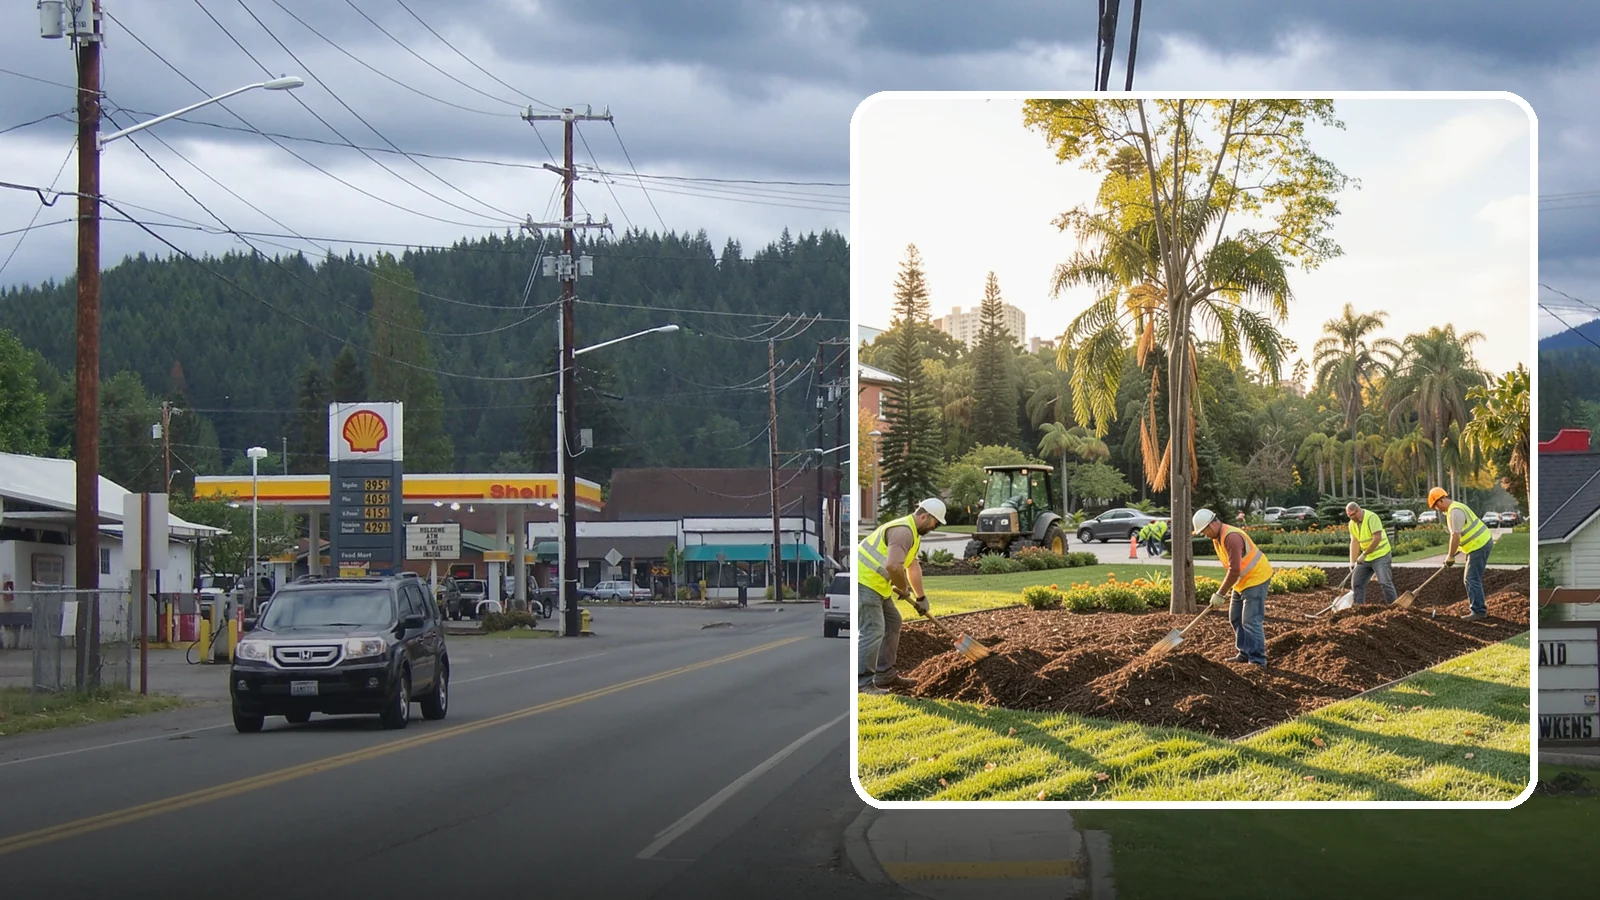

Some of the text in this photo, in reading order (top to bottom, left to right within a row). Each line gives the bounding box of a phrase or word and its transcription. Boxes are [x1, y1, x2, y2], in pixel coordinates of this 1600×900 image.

[366, 480, 384, 490] 395
[490, 484, 547, 498] Shell
[366, 494, 384, 504] 405
[366, 508, 383, 518] 415
[366, 522, 383, 532] 429
[1538, 643, 1566, 665] AID
[1538, 716, 1592, 738] WKENS
